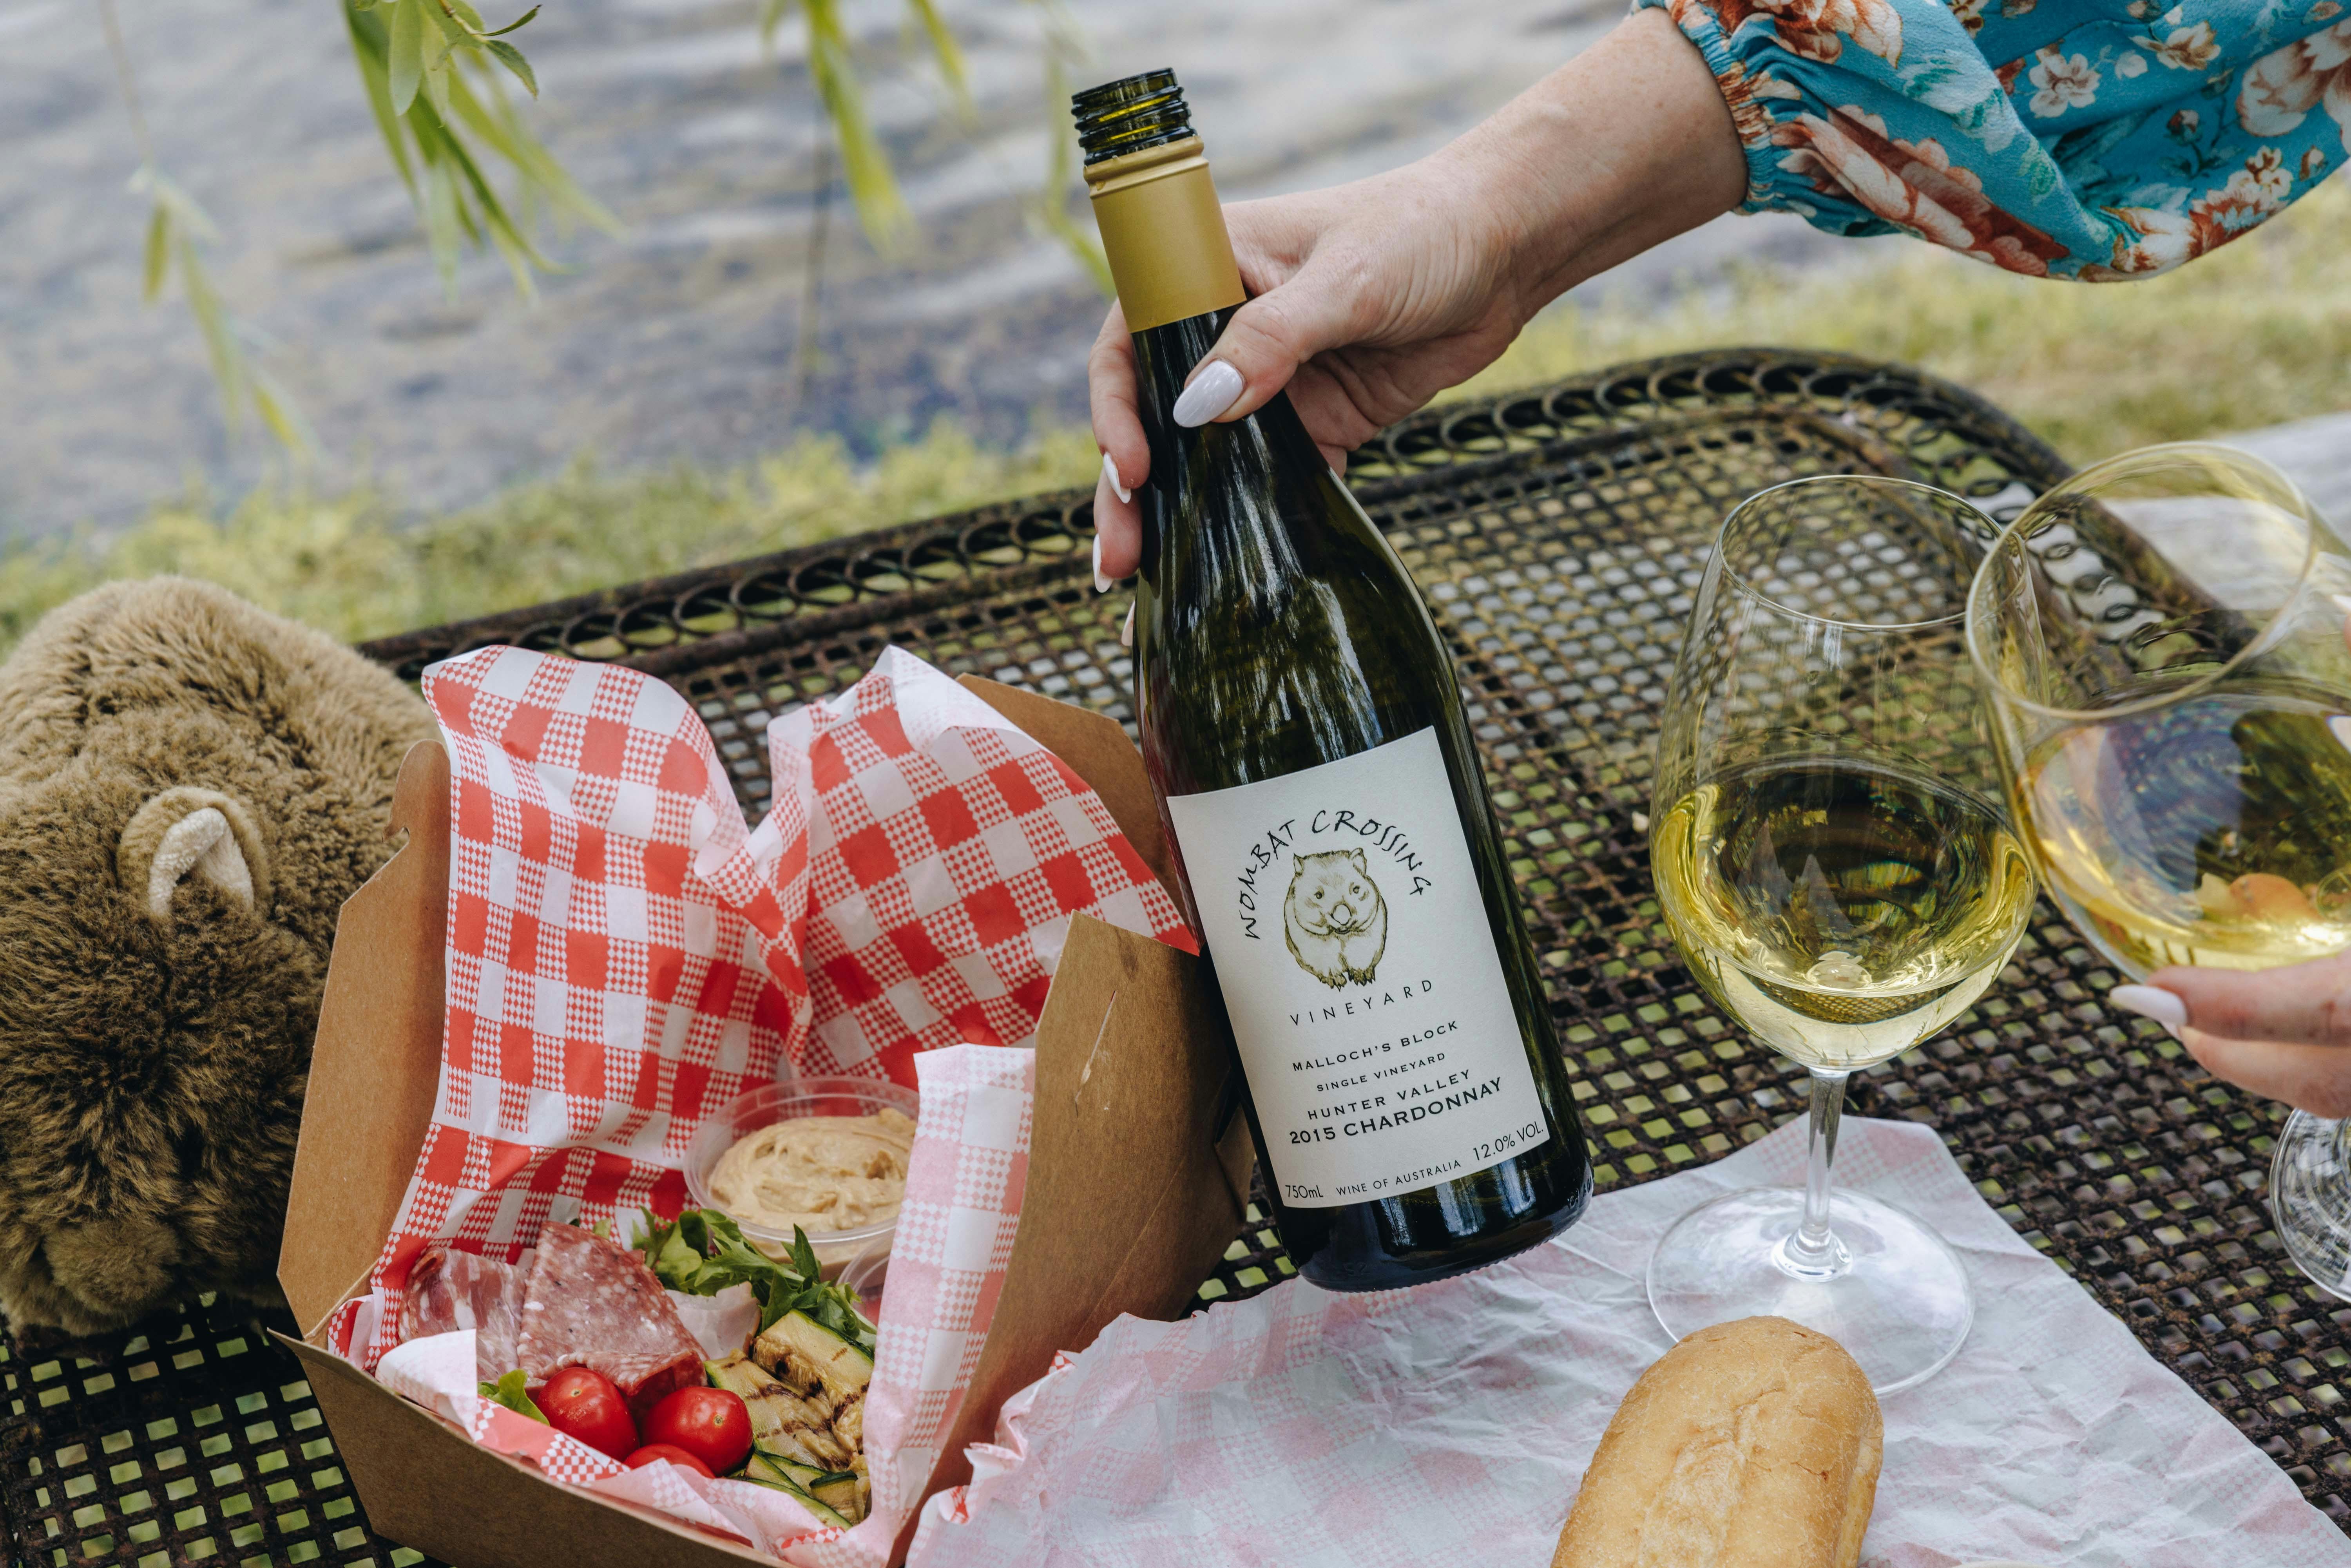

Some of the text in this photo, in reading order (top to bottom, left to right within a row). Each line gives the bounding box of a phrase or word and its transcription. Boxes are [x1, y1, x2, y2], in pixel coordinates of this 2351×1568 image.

[1237, 810, 1431, 940] WOMBAT CROSSING
[1290, 980, 1431, 1026] VINEYARD
[1292, 1021, 1457, 1071] MALLOCH'S BLOCK
[1308, 1069, 1469, 1120] HUNTER VALLEY
[1317, 1053, 1445, 1092] SINGLE VINEYARD
[1290, 1077, 1500, 1144] 2015 CHARDONNAY
[1473, 1121, 1543, 1161] 12.0% VOL.
[1285, 1184, 1324, 1199] 750mL
[1336, 1160, 1461, 1195] WINE OF AUSTRALIA
